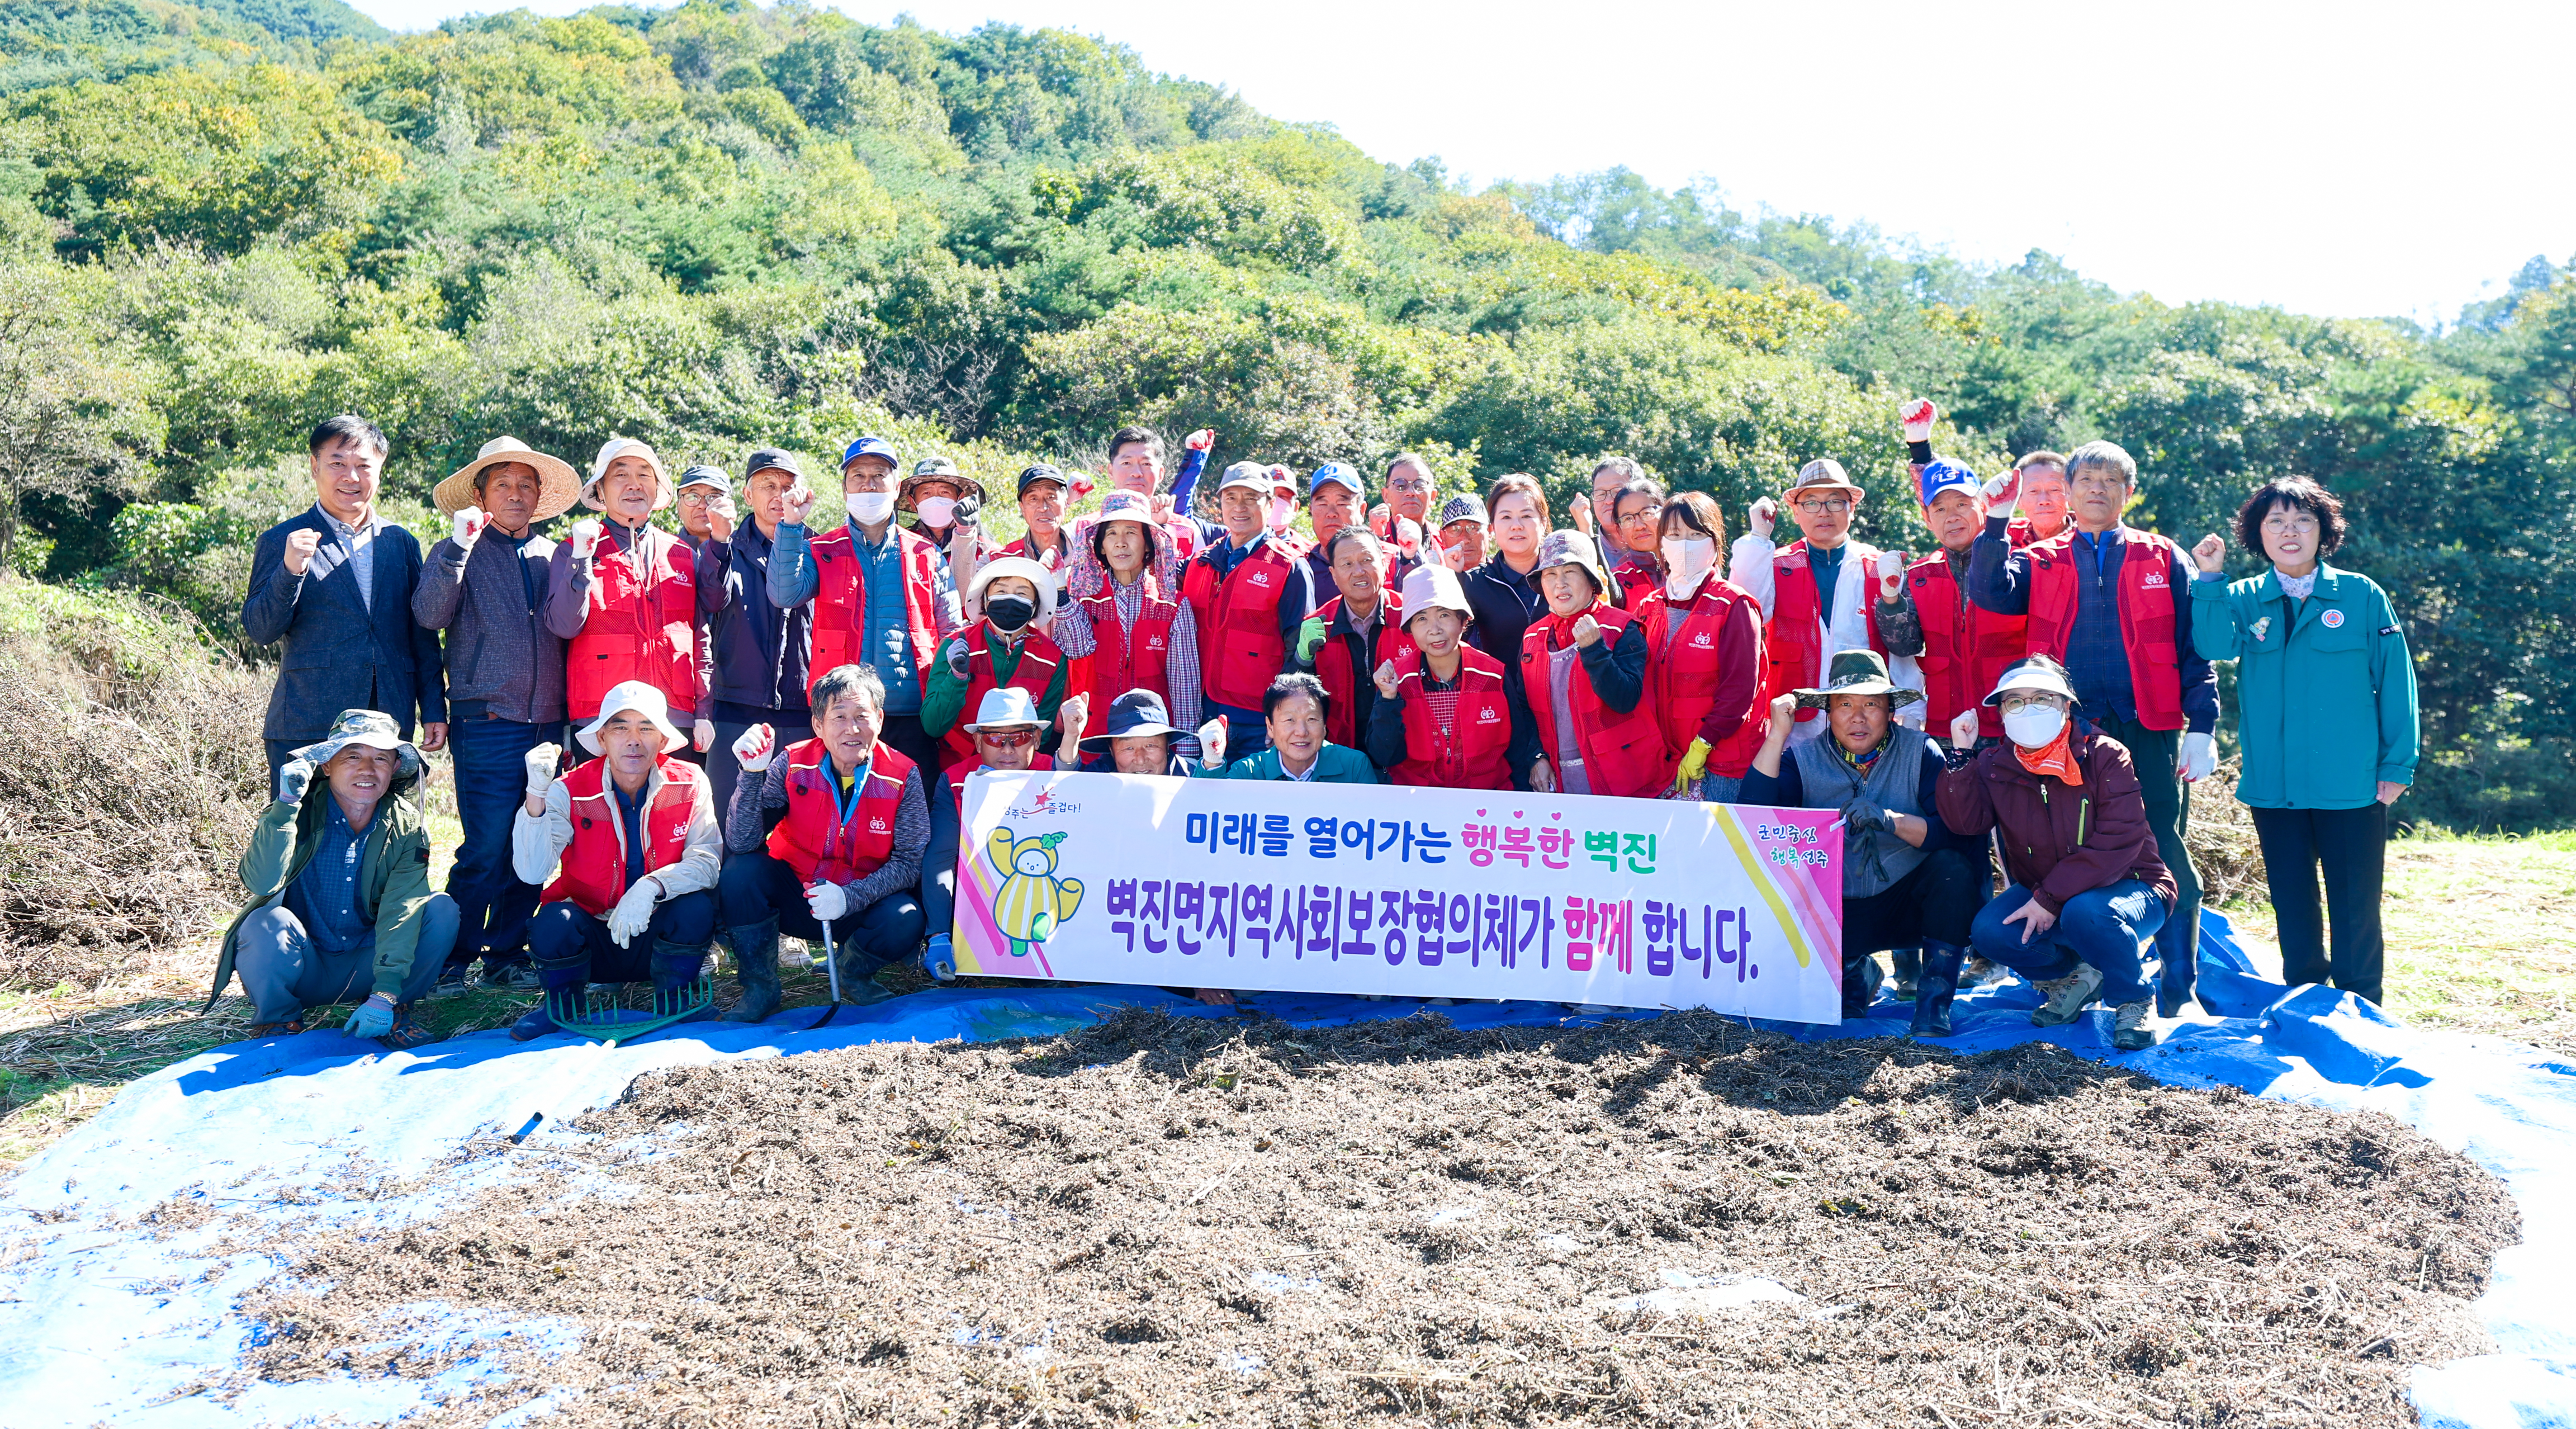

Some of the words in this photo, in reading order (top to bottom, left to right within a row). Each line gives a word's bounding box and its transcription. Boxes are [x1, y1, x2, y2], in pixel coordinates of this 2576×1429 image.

[1938, 472, 1957, 482] LS
[1048, 802, 1081, 815] 즐겁다!
[1186, 811, 1295, 858] 미래를
[1304, 817, 1452, 864] 열어가는
[1461, 823, 1575, 869] 행복한
[1584, 830, 1656, 874] 벽진
[1758, 824, 1817, 843] 군민중심
[1771, 847, 1829, 868] 행복성주
[1107, 878, 1555, 969] 벽진면지역사회보장협의체가
[1563, 896, 1633, 974] 함께
[1642, 899, 1759, 983] 합니다.
